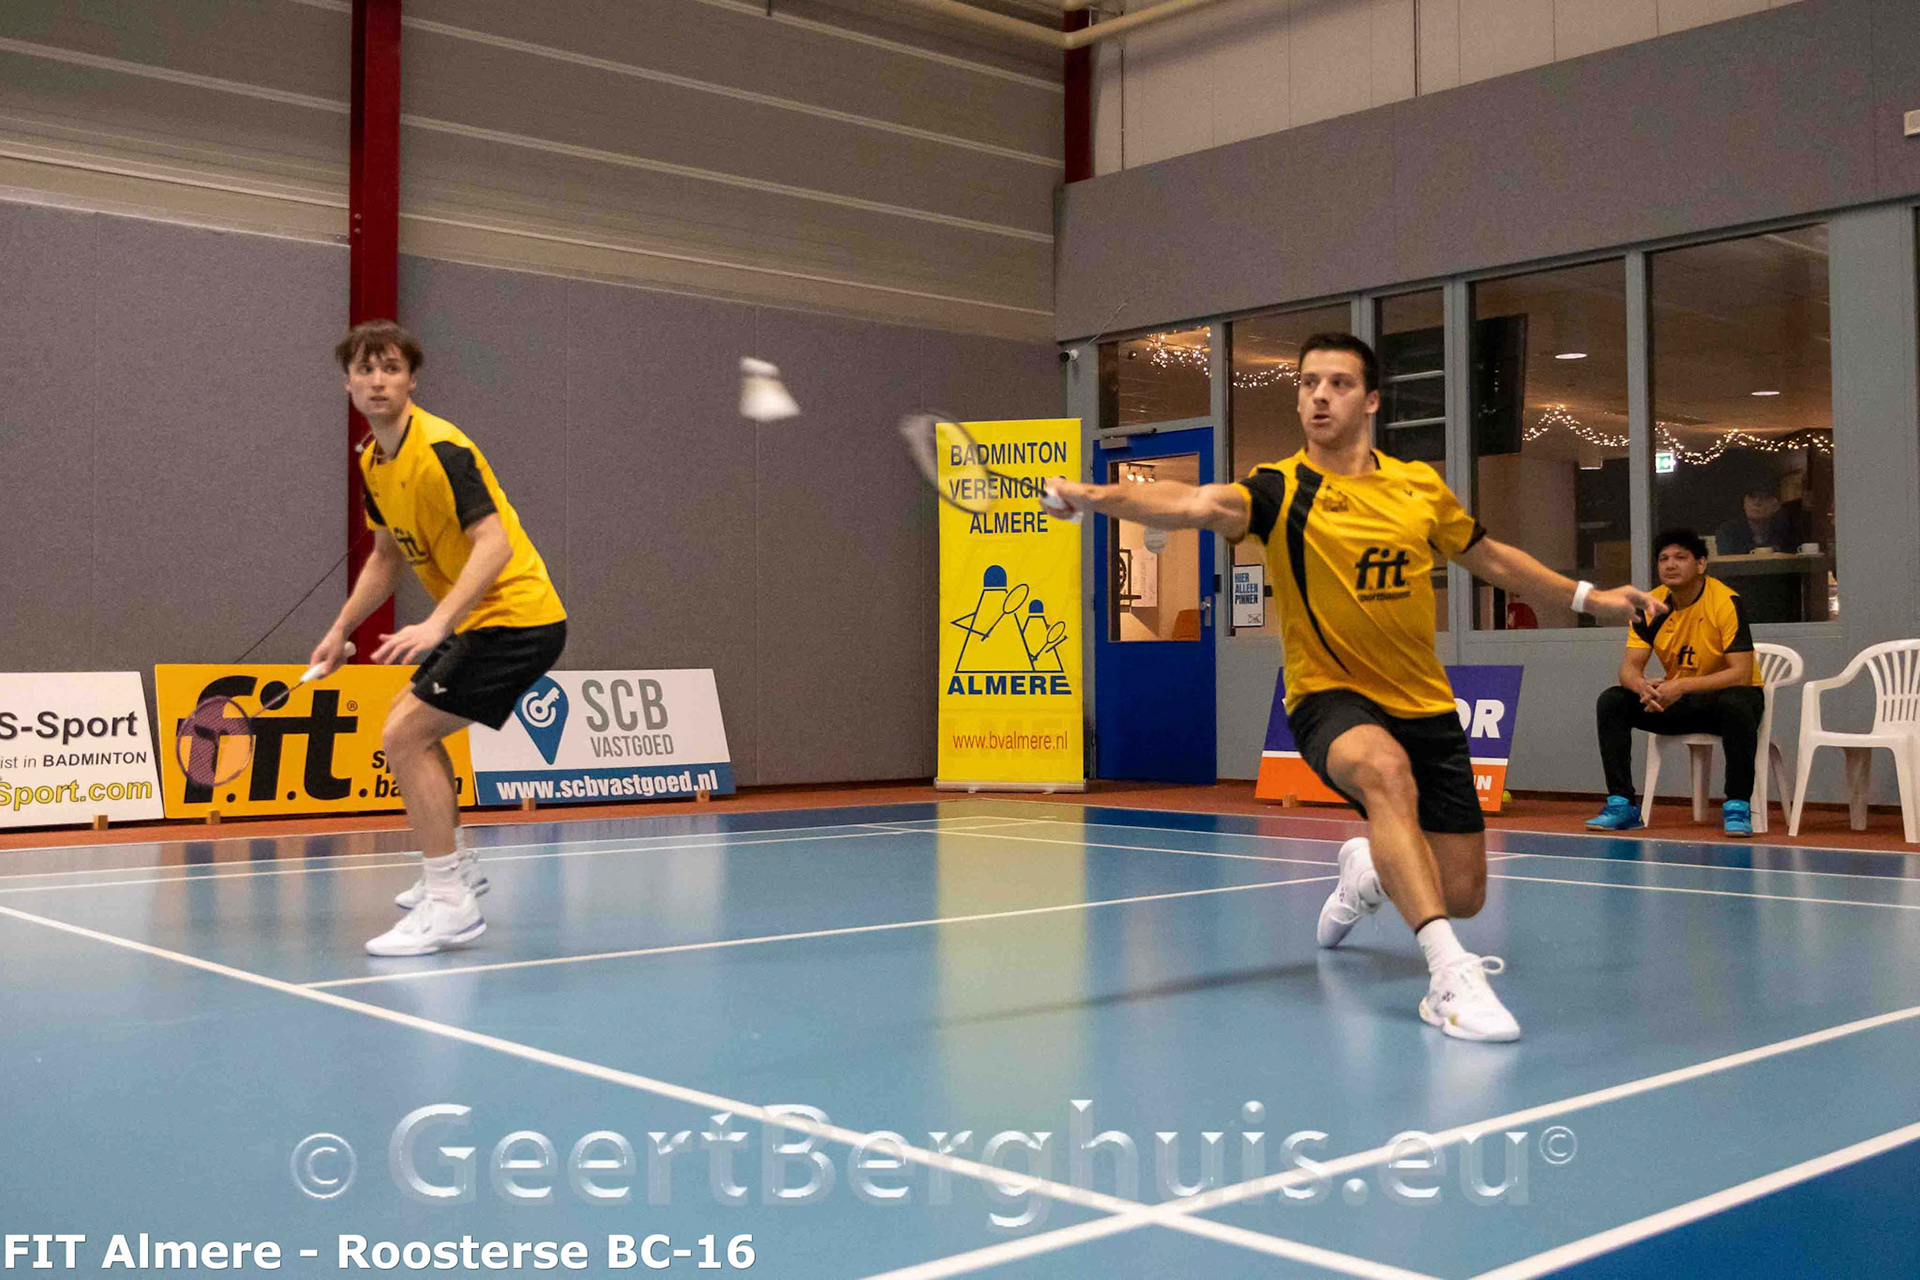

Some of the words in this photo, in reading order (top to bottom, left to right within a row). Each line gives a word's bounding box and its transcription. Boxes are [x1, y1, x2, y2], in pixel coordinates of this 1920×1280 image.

[950, 441, 1067, 466] BADMINTON
[949, 475, 1067, 500] VERENIGI
[969, 511, 1049, 534] ALMERE
[1234, 583, 1259, 594] ALLEEN
[947, 675, 1072, 695] ALMERE
[581, 678, 669, 732] SCB
[0, 710, 138, 746] S-Sport
[952, 731, 1068, 750] www.bvalmere.nl
[590, 733, 674, 758] VASTGOED
[23, 755, 37, 768] in
[43, 751, 147, 768] BADMINTON
[496, 769, 719, 801] www.scbvastgoed.nl
